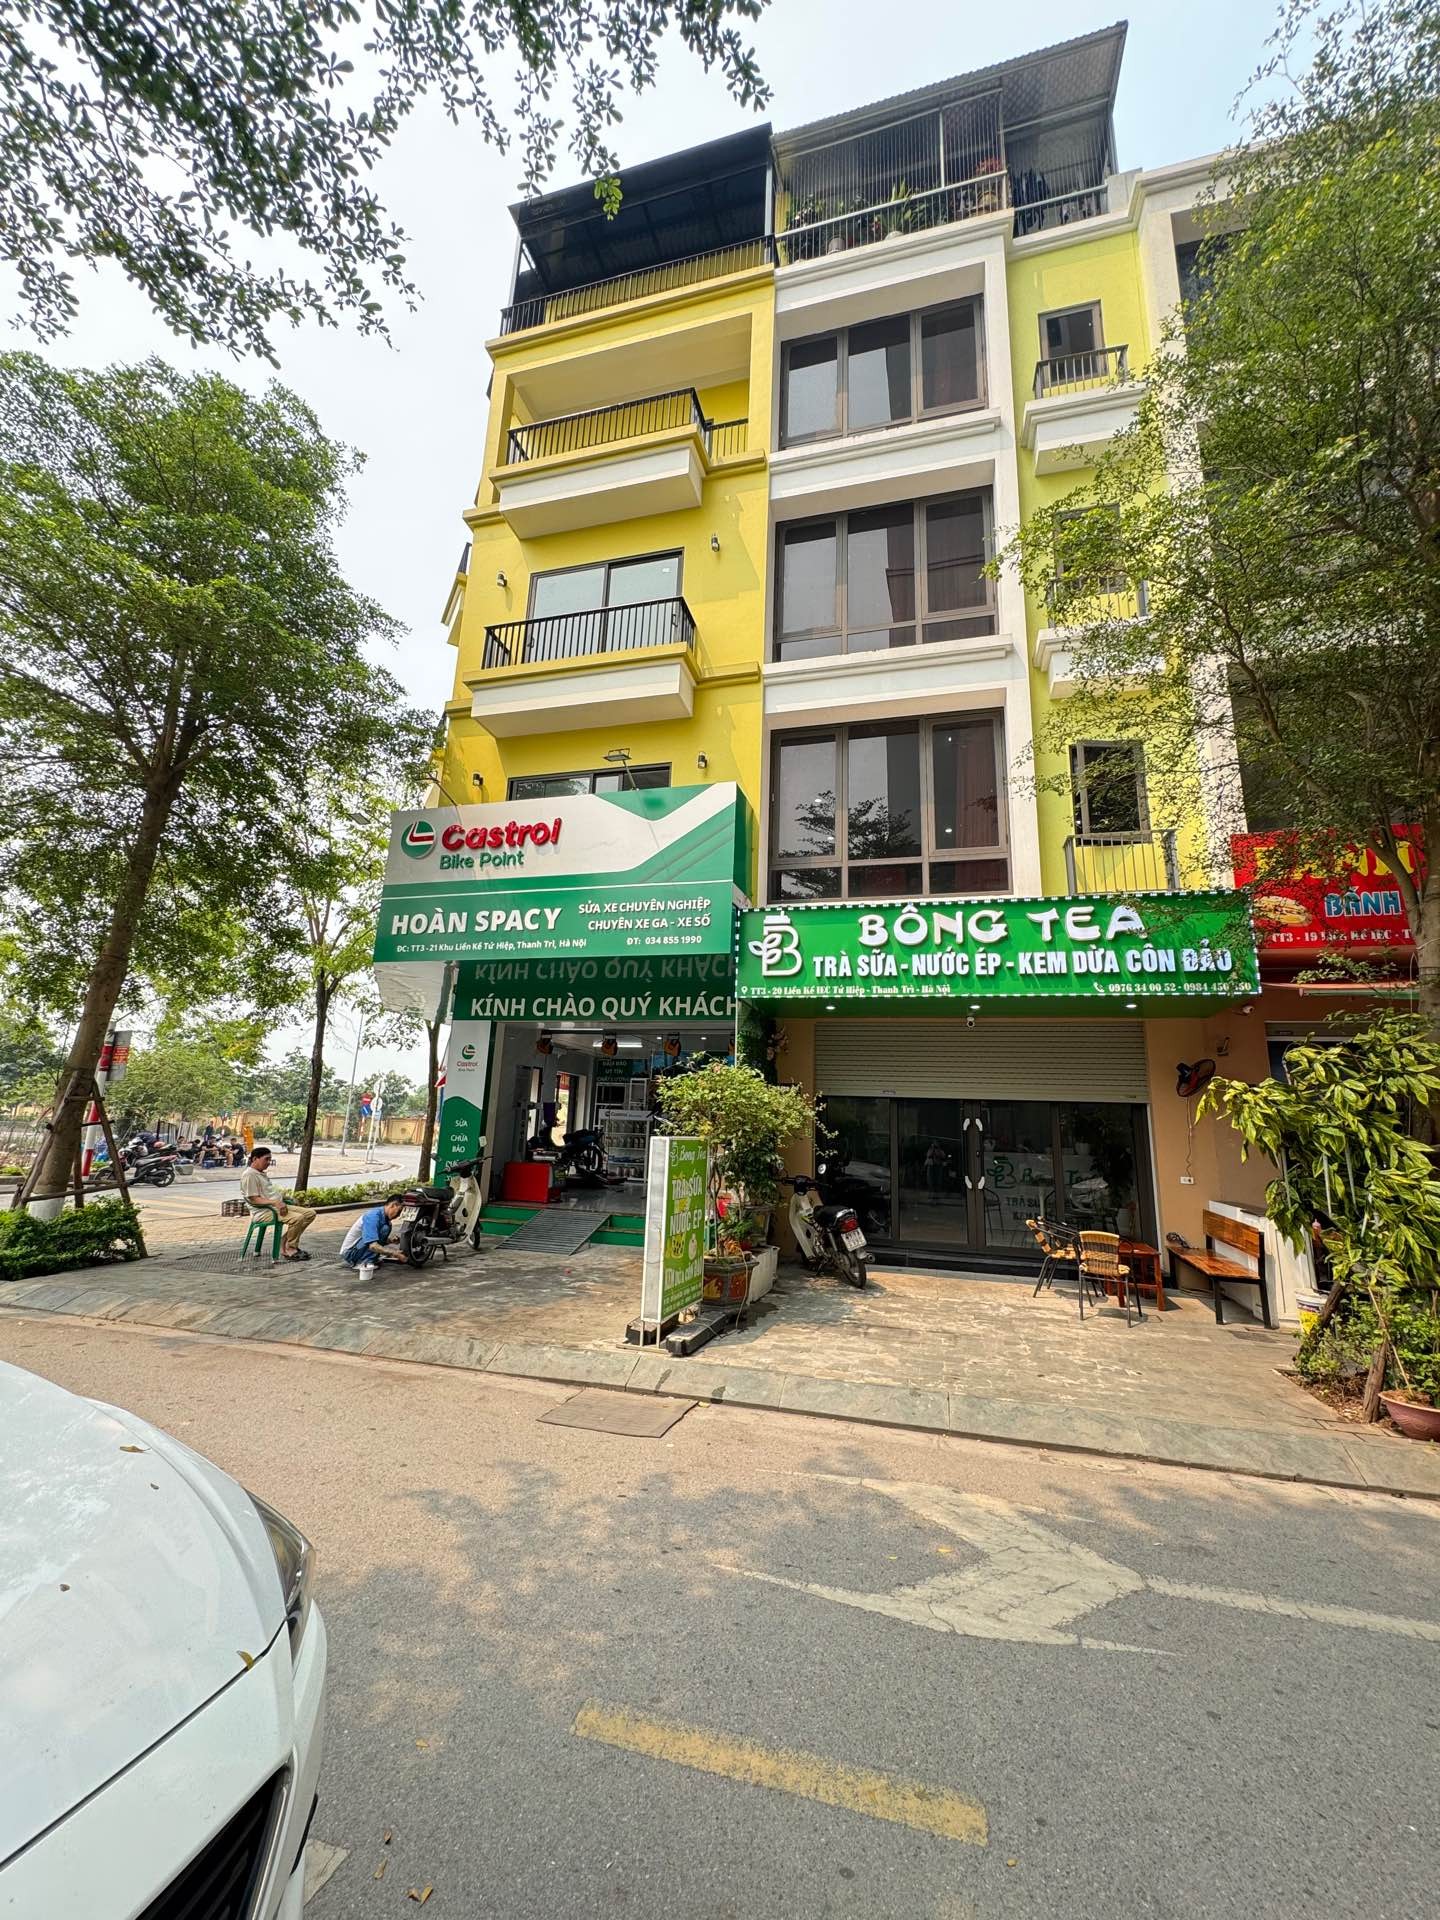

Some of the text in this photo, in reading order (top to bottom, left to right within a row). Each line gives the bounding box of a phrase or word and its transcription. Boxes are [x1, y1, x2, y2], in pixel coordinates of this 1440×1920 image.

[441, 817, 562, 850] Castrol
[440, 851, 524, 870] Bike Point
[578, 896, 711, 914] SỬA XE CHUYÊN NGHIỆP
[391, 908, 563, 935] HOÀN SPACY
[588, 917, 632, 930] CHUYÊN
[635, 918, 649, 929] XE
[652, 918, 668, 928] GA
[677, 917, 692, 927] XE
[694, 913, 711, 926] SỐ
[858, 904, 1148, 946] BÔNG TEA
[410, 944, 425, 952] TT3
[429, 944, 438, 952] 21
[439, 943, 454, 951] Khu
[517, 939, 542, 949] Thanh
[559, 938, 570, 948] Hà
[572, 938, 587, 949] Nội
[645, 936, 661, 945] 034
[663, 936, 679, 945] 855
[681, 935, 702, 944] 1990
[1304, 932, 1318, 942] 19
[813, 951, 851, 977] TRÀ
[857, 949, 898, 977] SỮA
[912, 946, 969, 976] NƯỚC
[975, 947, 1001, 975] ÉP
[1018, 951, 1067, 975] KEM
[1072, 944, 1120, 974] DỪA
[1126, 943, 1176, 972] CÔN
[750, 987, 766, 995] TT3
[772, 986, 783, 995] 20
[845, 985, 865, 997] Hiệp
[871, 985, 899, 994] Thanh
[901, 984, 914, 994] Trì
[921, 984, 933, 993] Hà
[936, 983, 951, 995] Nội
[1108, 982, 1132, 992] 0976
[1134, 982, 1147, 992] 34
[1149, 982, 1162, 992] 00
[1164, 982, 1177, 992] 52
[1232, 982, 1252, 991] 50
[470, 990, 737, 1020] KÍNH CHÀO QUÝ KHÁCH
